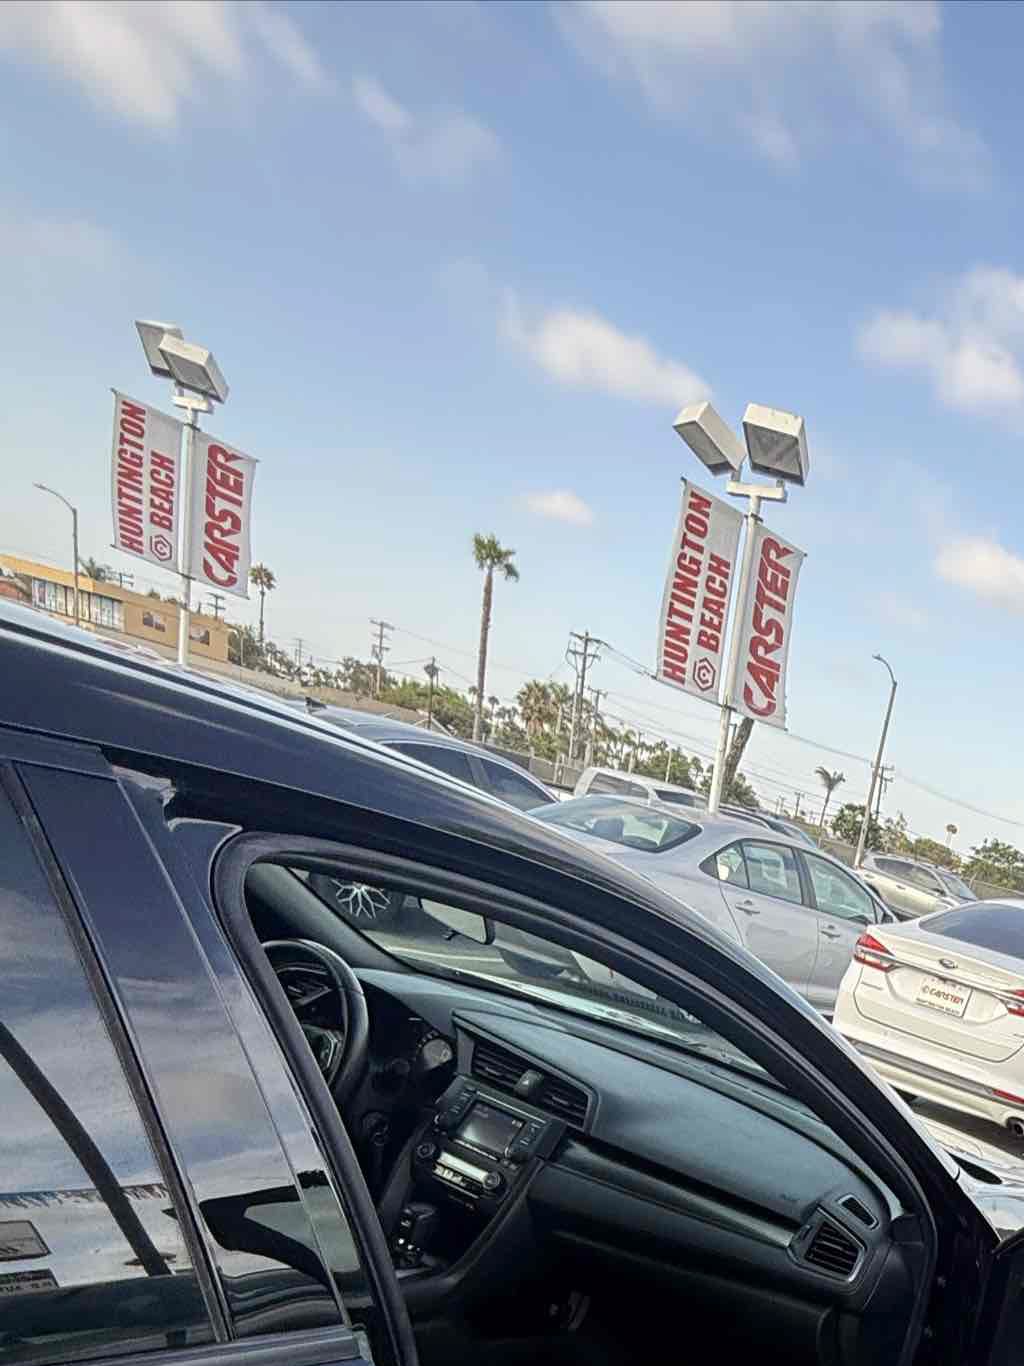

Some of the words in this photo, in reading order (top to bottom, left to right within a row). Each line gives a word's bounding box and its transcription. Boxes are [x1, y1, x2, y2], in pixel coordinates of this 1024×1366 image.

[117, 400, 146, 555] HUNTINGTON
[150, 450, 175, 532] BEACH
[203, 443, 244, 588] CARSTER
[663, 491, 712, 685] HUNTINGTON
[697, 553, 731, 654] BEACH
[743, 536, 795, 717] CARSTER
